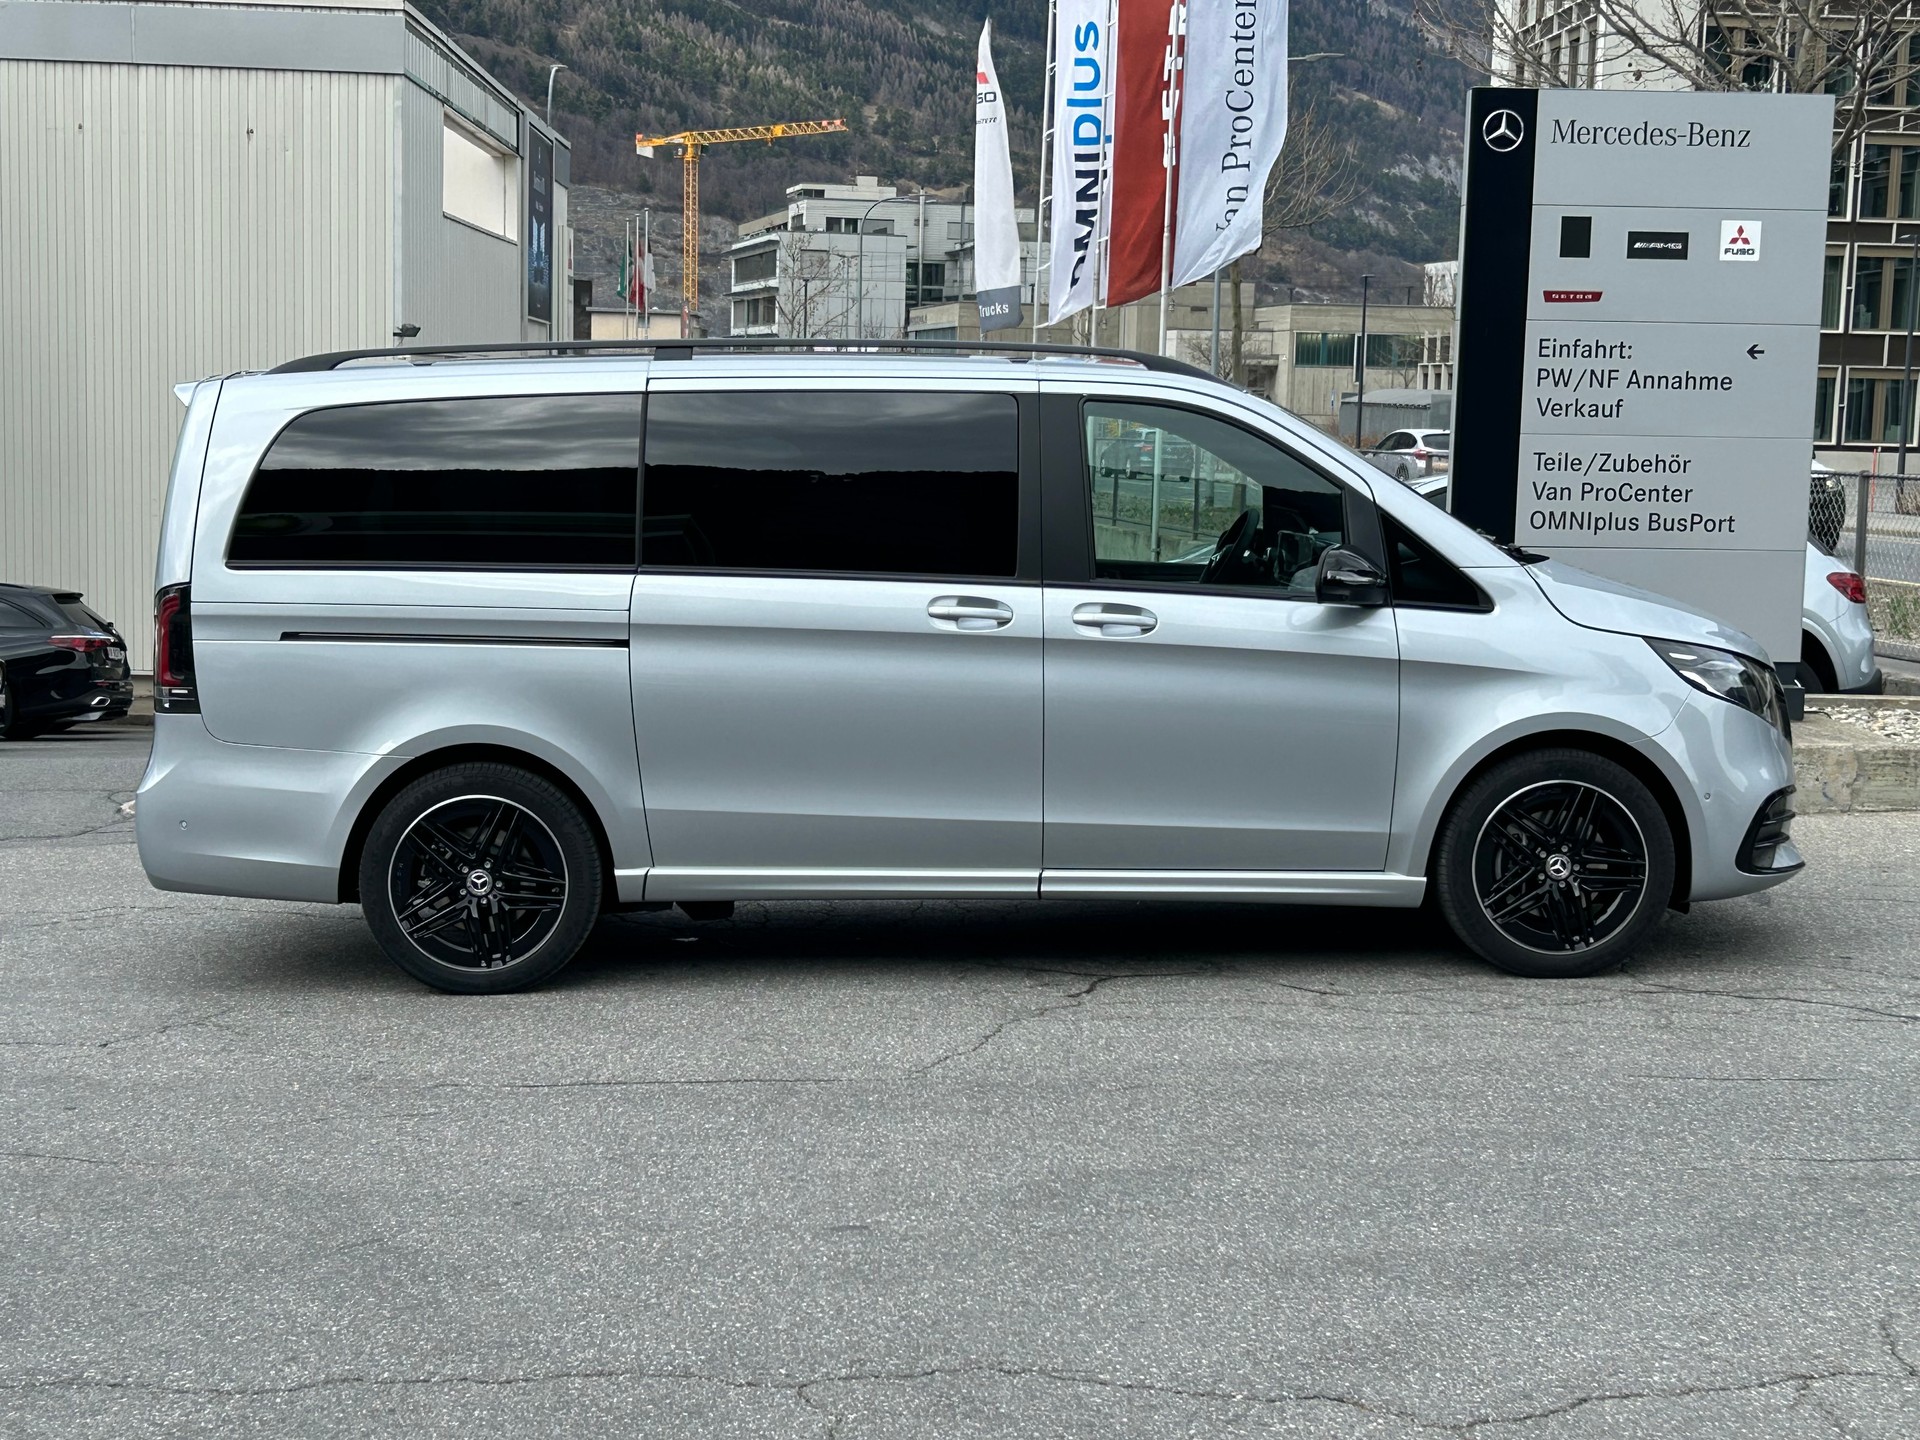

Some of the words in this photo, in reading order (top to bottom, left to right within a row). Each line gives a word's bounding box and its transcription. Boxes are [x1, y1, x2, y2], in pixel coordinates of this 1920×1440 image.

[1222, 0, 1257, 173] ProCenter
[1551, 118, 1751, 148] Mercedes-Benz
[1724, 247, 1755, 256] FUSO
[979, 302, 1009, 318] Trucks
[1538, 337, 1633, 360] Einfahrt:
[1536, 368, 1620, 393] PW/NF
[1626, 370, 1733, 391] Annahme
[1536, 397, 1623, 418] Verkauf
[1532, 451, 1692, 476] Teile/Zubehör
[1532, 481, 1572, 501] Van
[1580, 482, 1693, 503] ProCenter
[1529, 511, 1639, 535] OMNIplus
[1648, 513, 1735, 533] BusPort
